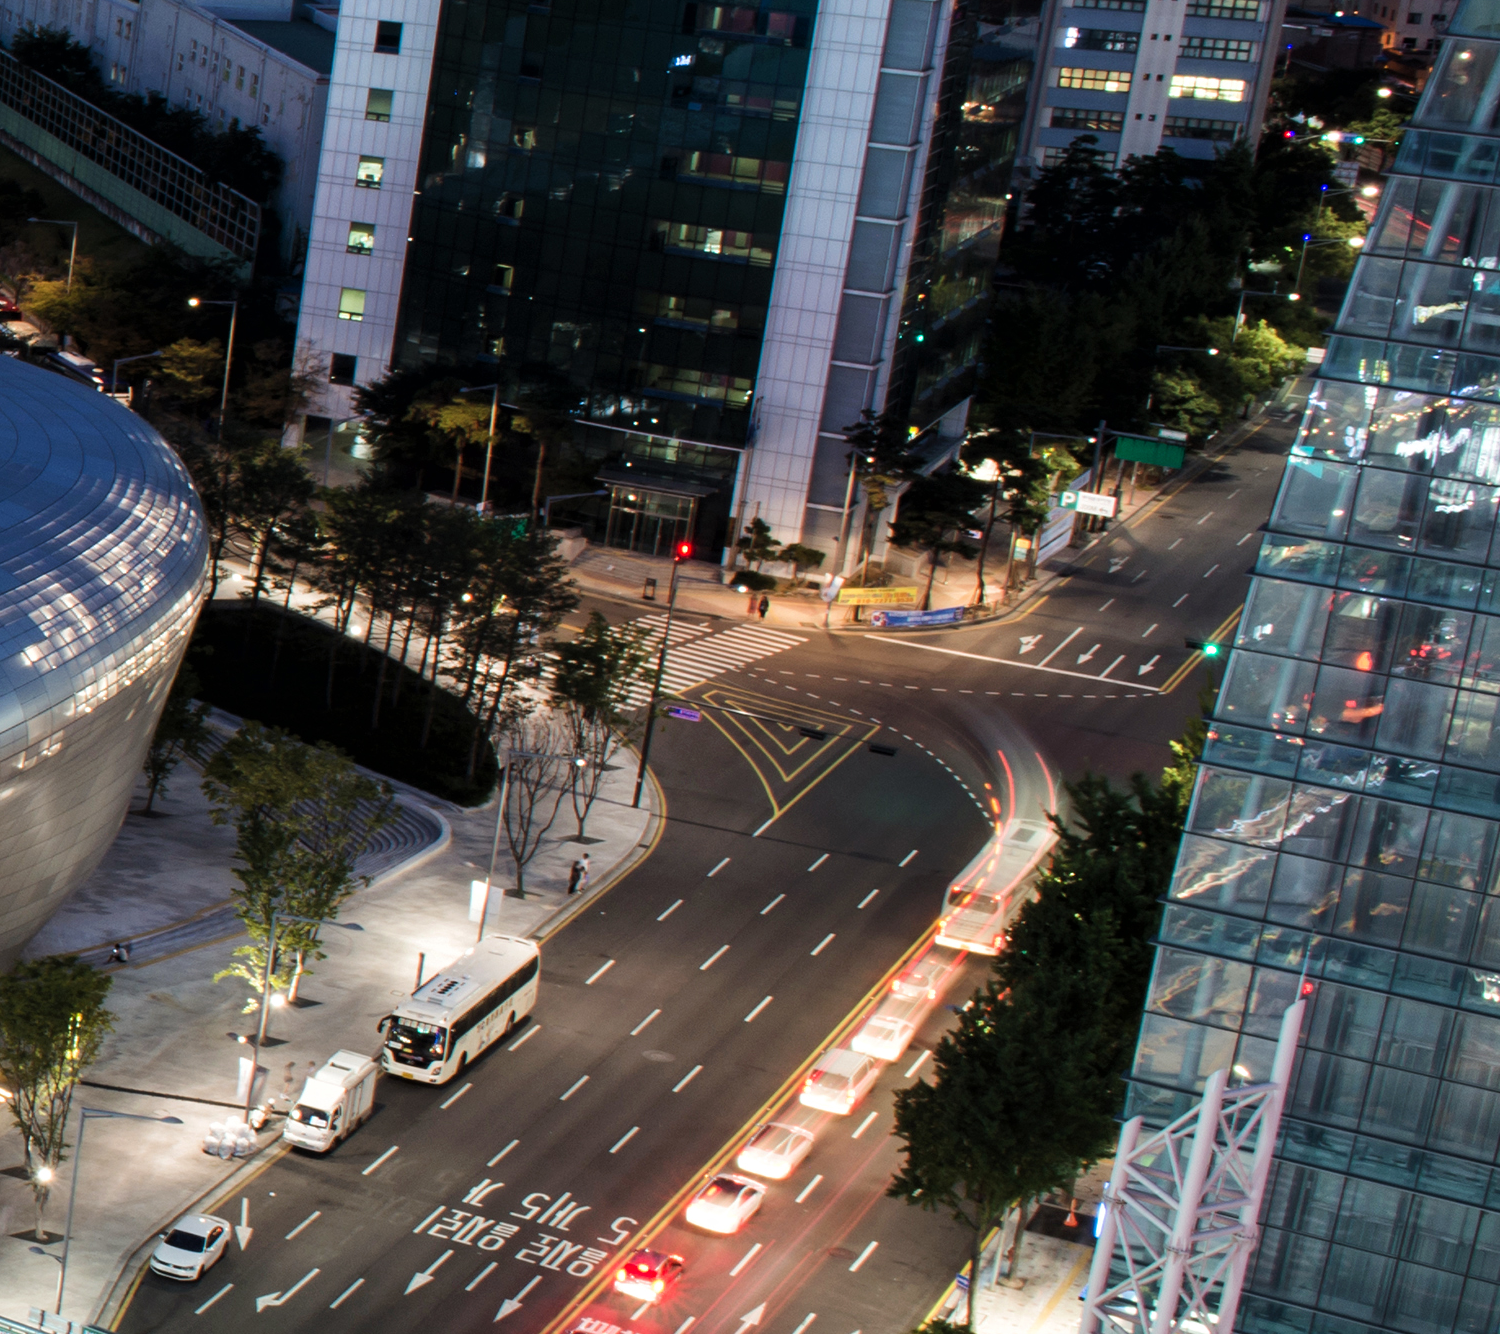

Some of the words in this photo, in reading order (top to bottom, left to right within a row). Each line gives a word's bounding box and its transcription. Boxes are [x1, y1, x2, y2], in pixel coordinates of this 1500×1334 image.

[1060, 491, 1077, 508] P
[426, 1208, 521, 1252] 을지로
[514, 1232, 609, 1277] 을지로
